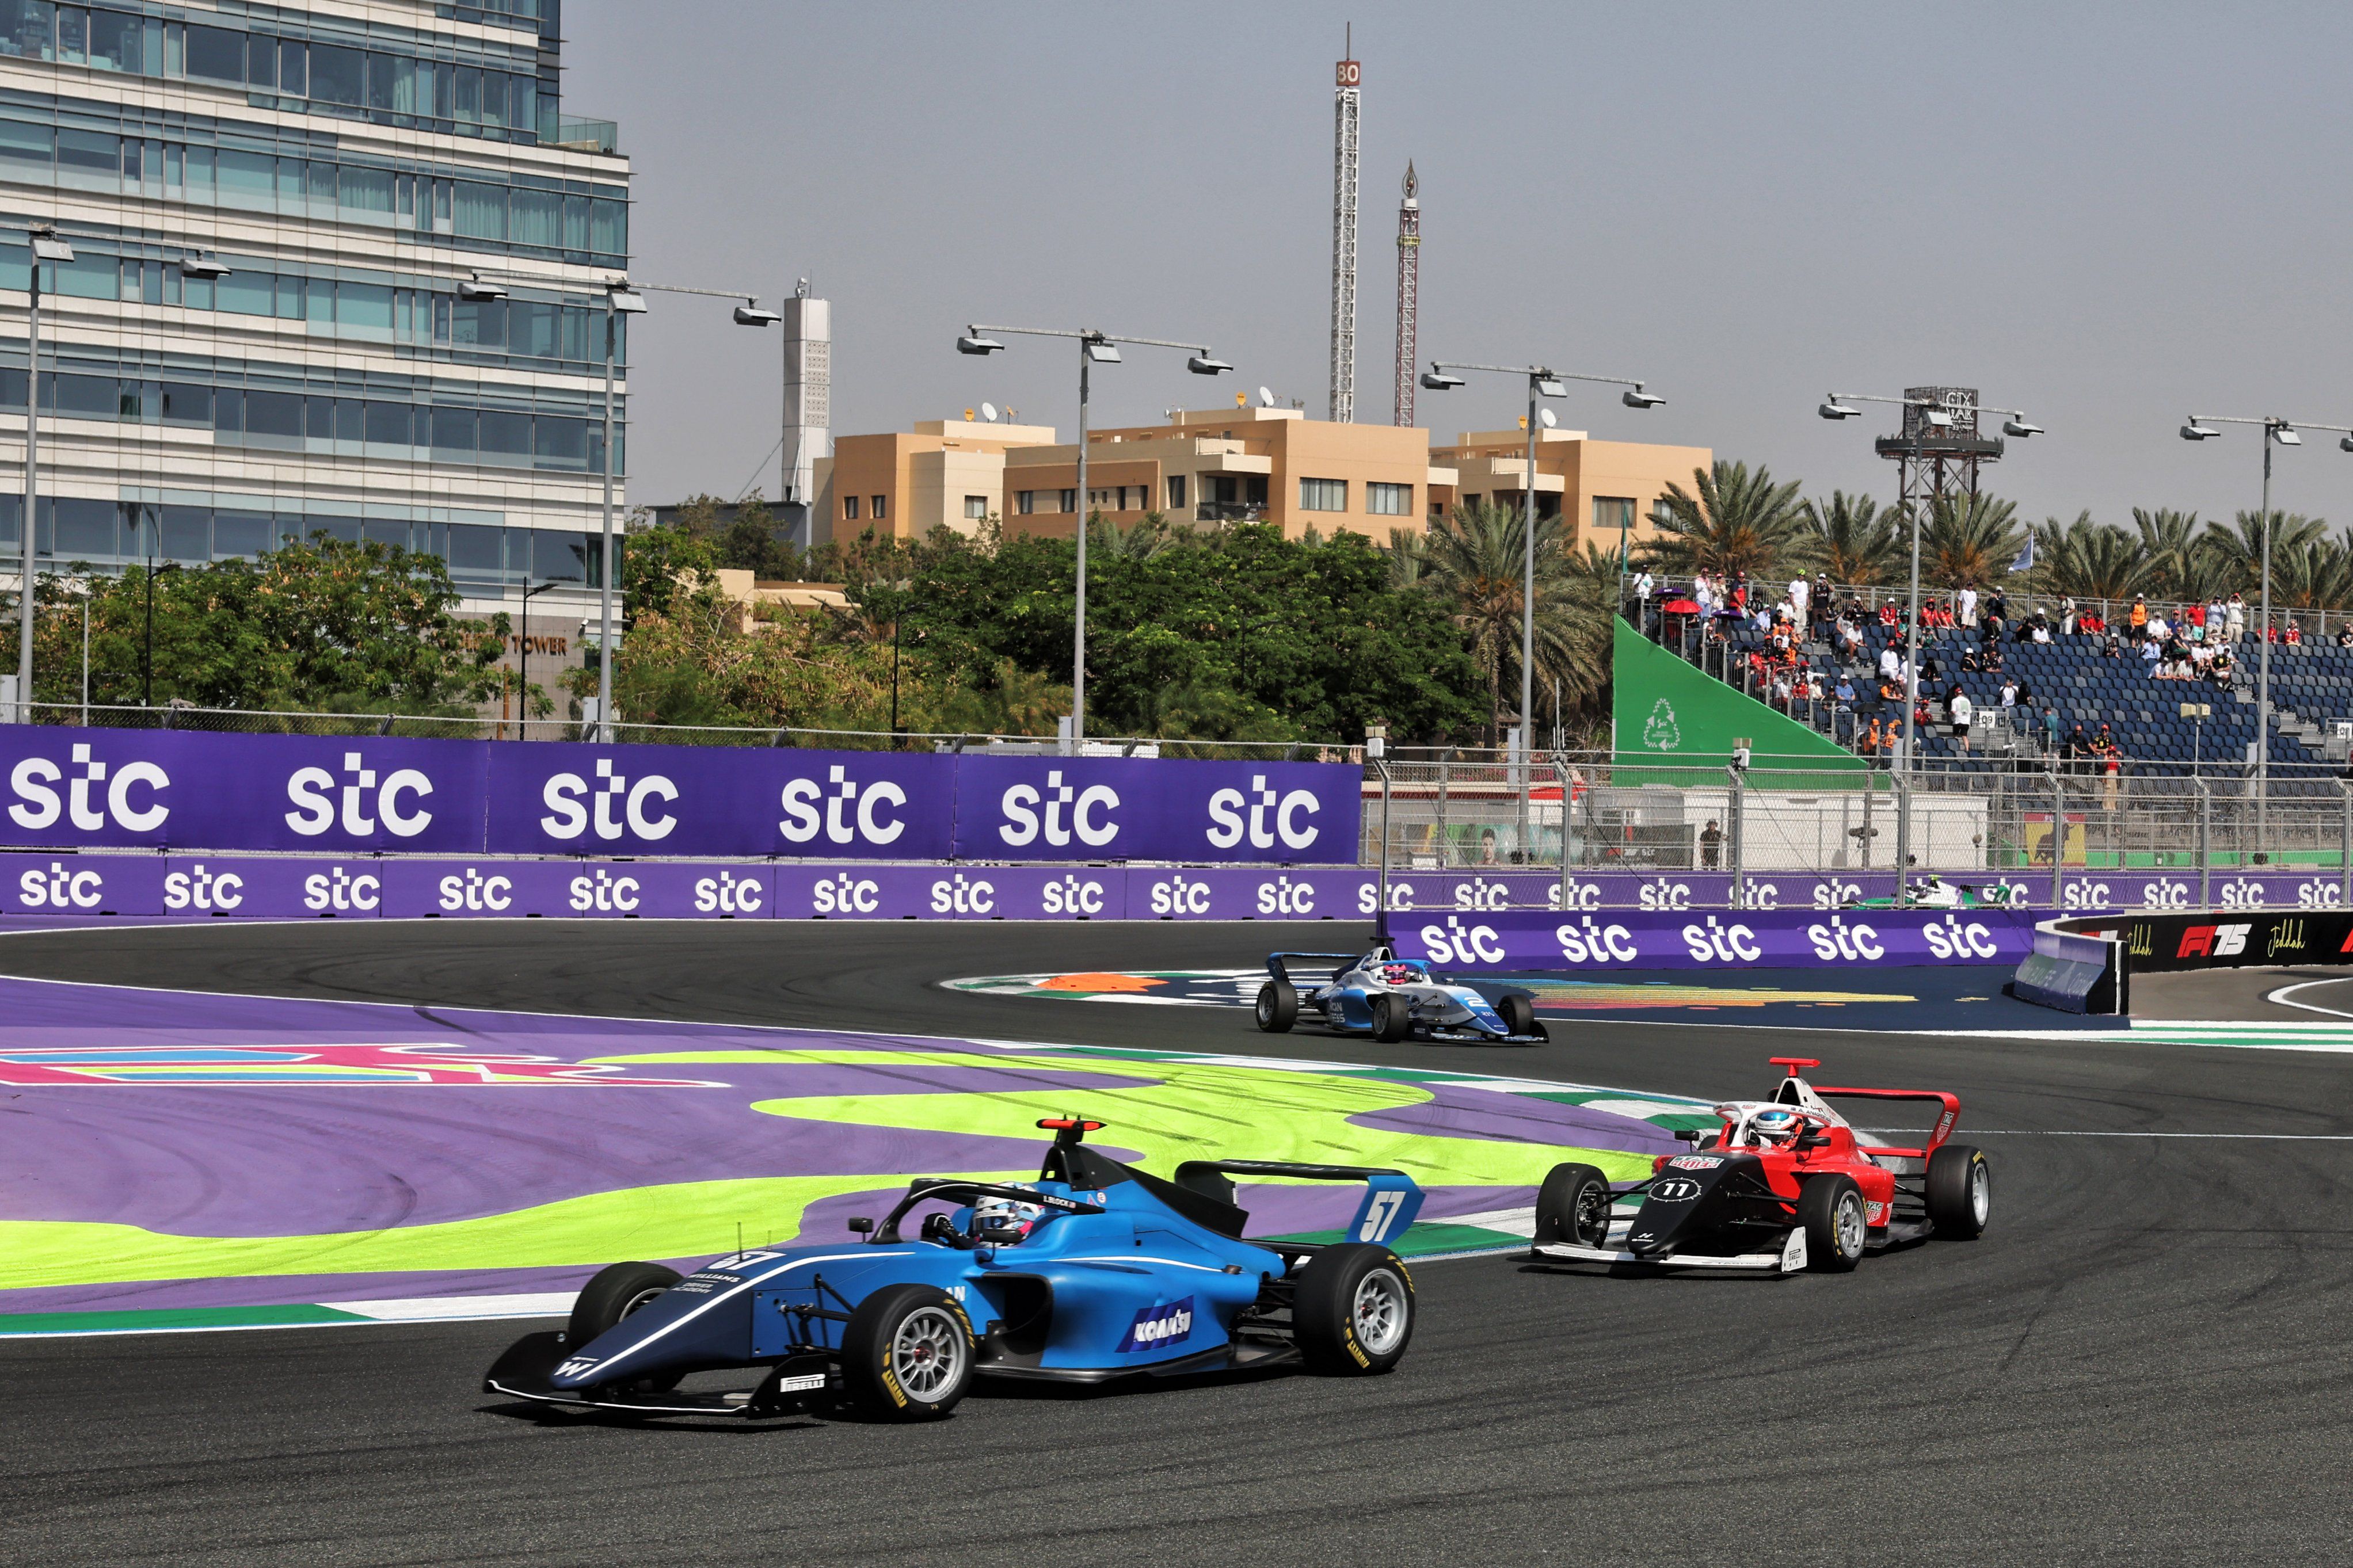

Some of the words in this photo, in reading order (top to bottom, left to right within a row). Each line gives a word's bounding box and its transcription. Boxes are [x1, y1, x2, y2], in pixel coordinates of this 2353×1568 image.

[1337, 64, 1359, 82] 80
[511, 635, 568, 653] TOWER
[1982, 715, 1993, 724] 09
[9, 743, 170, 831] stc
[285, 752, 433, 837] stc
[541, 759, 679, 840] stc
[779, 765, 907, 844] stc
[999, 770, 1120, 846] stc
[1206, 775, 1320, 849] stc
[20, 862, 102, 907] stc
[165, 865, 243, 909] stc
[304, 867, 380, 910] stc
[439, 868, 512, 910] stc
[569, 869, 639, 911] stc
[694, 871, 762, 912] stc
[813, 872, 879, 913] stc
[931, 873, 994, 913] stc
[1042, 875, 1103, 913] stc
[1151, 875, 1210, 914] stc
[1257, 876, 1315, 914] stc
[1358, 883, 1414, 914] sc
[1455, 878, 1509, 911] stc
[1640, 878, 1690, 911] stc
[2065, 878, 2110, 909] stc
[2143, 877, 2188, 909] stc
[2221, 878, 2264, 909] stc
[2298, 878, 2340, 909] stc
[1421, 915, 1505, 963] stc
[1556, 915, 1637, 963] stc
[1682, 915, 1761, 962] stc
[1808, 915, 1884, 960] stc
[1923, 914, 1997, 959] stc
[2268, 918, 2306, 957] Jeddah
[1464, 997, 1490, 1007] 2
[1943, 1113, 1953, 1124] TAG
[1671, 1160, 1717, 1169] HEUER
[1663, 1183, 1689, 1197] 11
[1867, 1202, 1882, 1211] TAG
[1360, 1191, 1406, 1242] 57
[1865, 1211, 1880, 1221] EUER
[1789, 1249, 1801, 1261] PIRELLI
[688, 1273, 741, 1283] WILLIAMS
[554, 1361, 593, 1377] W
[780, 1374, 825, 1392] PIRELLI
